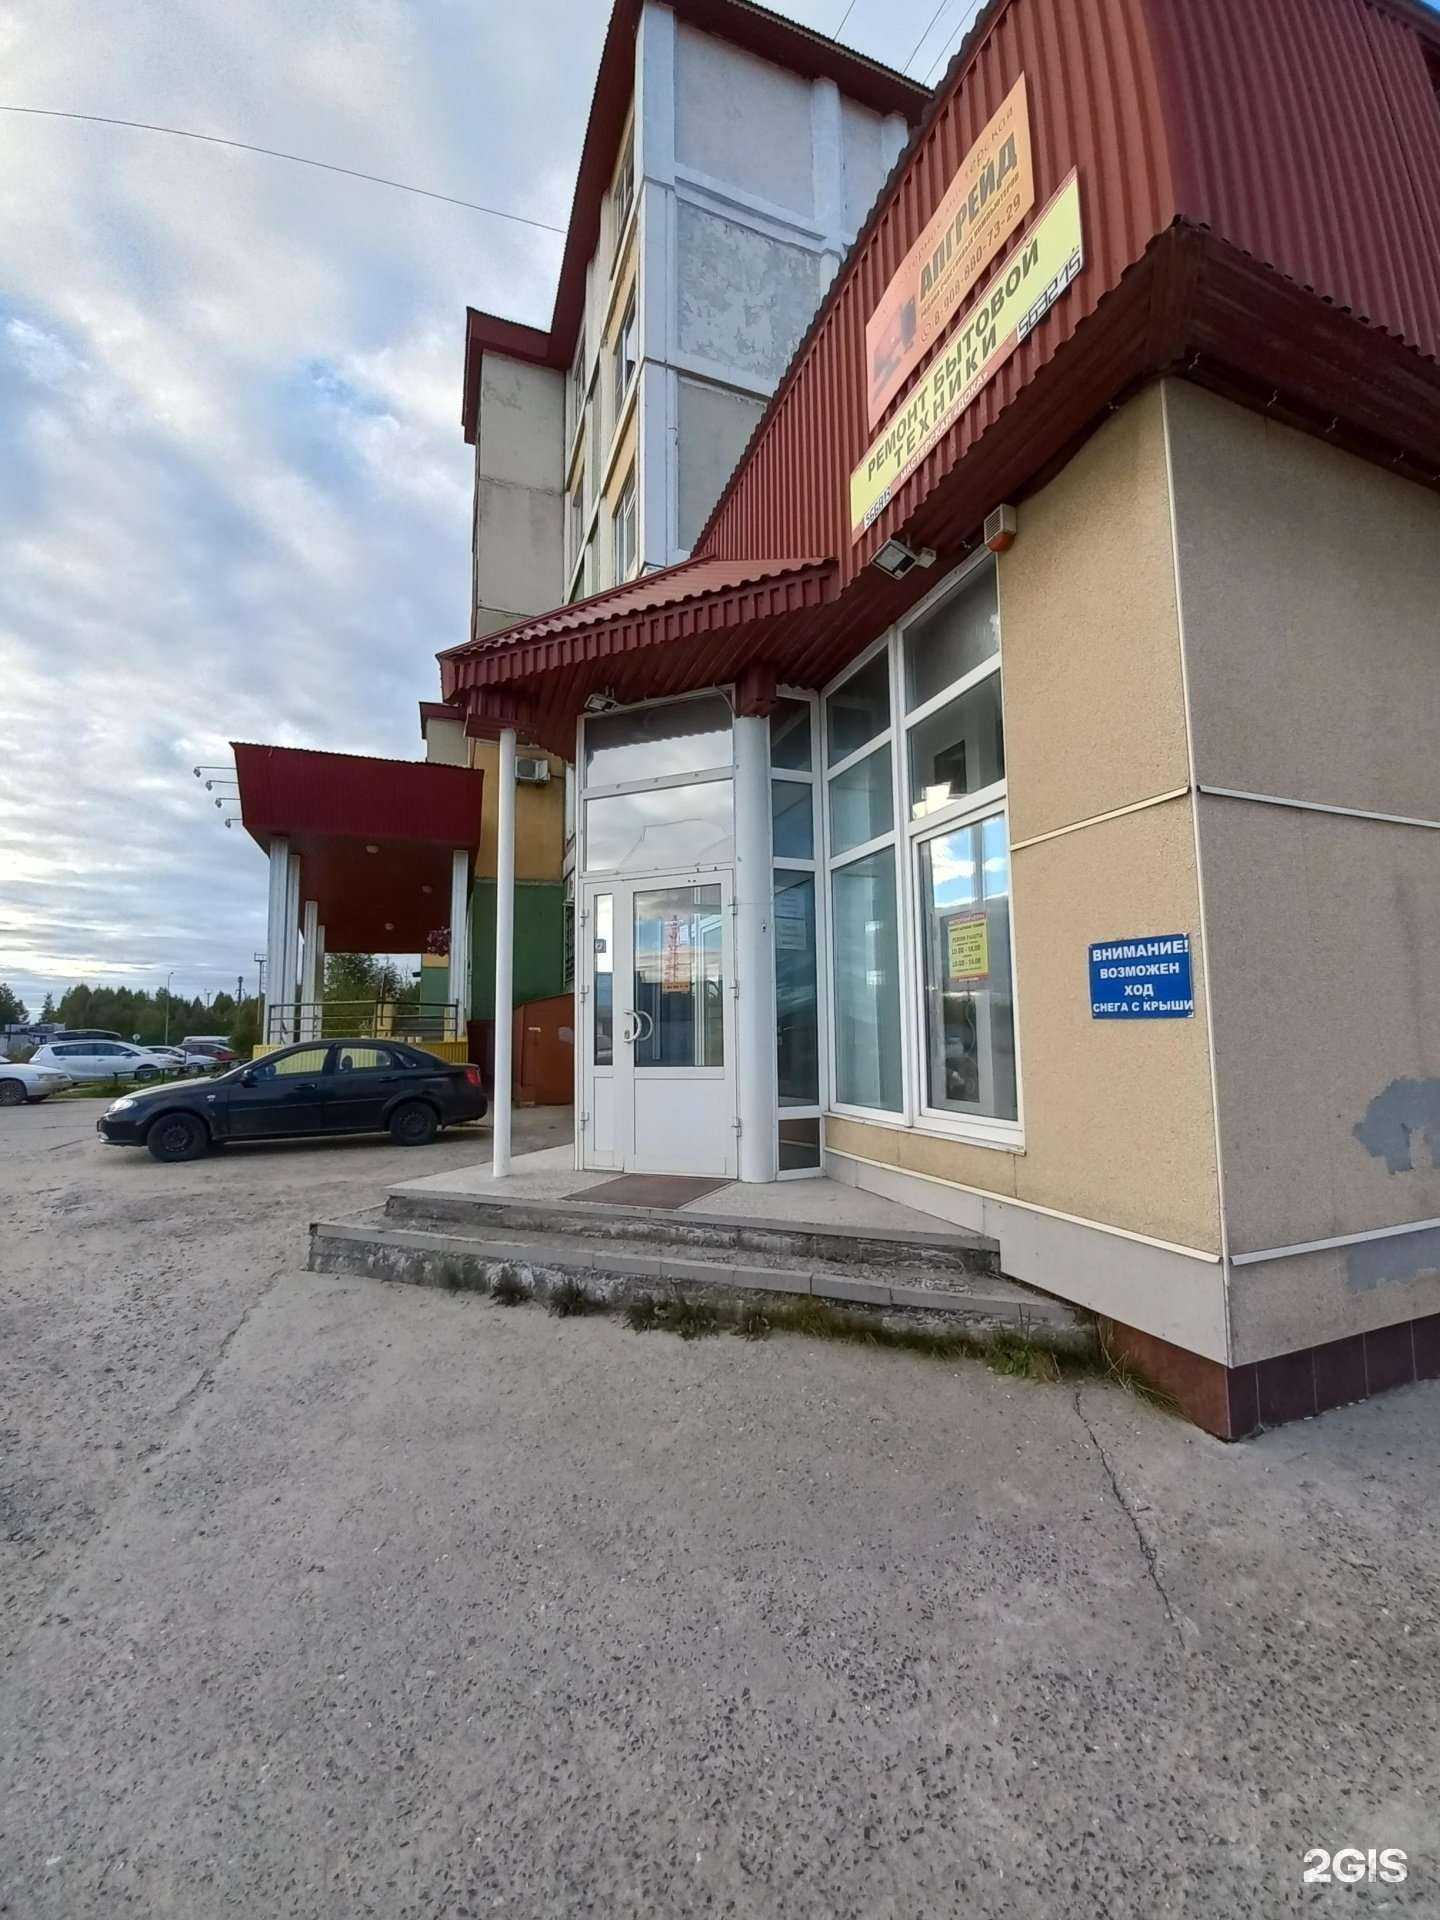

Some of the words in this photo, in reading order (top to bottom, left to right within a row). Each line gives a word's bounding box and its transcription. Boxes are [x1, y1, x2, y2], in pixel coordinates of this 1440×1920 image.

[920, 132, 1018, 302] АПГРЕЙД
[934, 193, 1021, 326] 8-908-880-73-29
[1018, 247, 1081, 341] 563215
[868, 384, 928, 482] РЕМОНТ
[933, 233, 1039, 396] БЫТОВОЙ
[894, 320, 997, 472] ТЕХНИКИ
[1092, 939, 1189, 962] ВНИМАНИЕ!
[1100, 962, 1180, 979] ВОЗМОЖЕН
[1124, 983, 1154, 997] ХОД
[1093, 1002, 1128, 1013] СНЕГА
[1131, 1001, 1140, 1012] С
[1143, 1000, 1194, 1011] КРЫШИ
